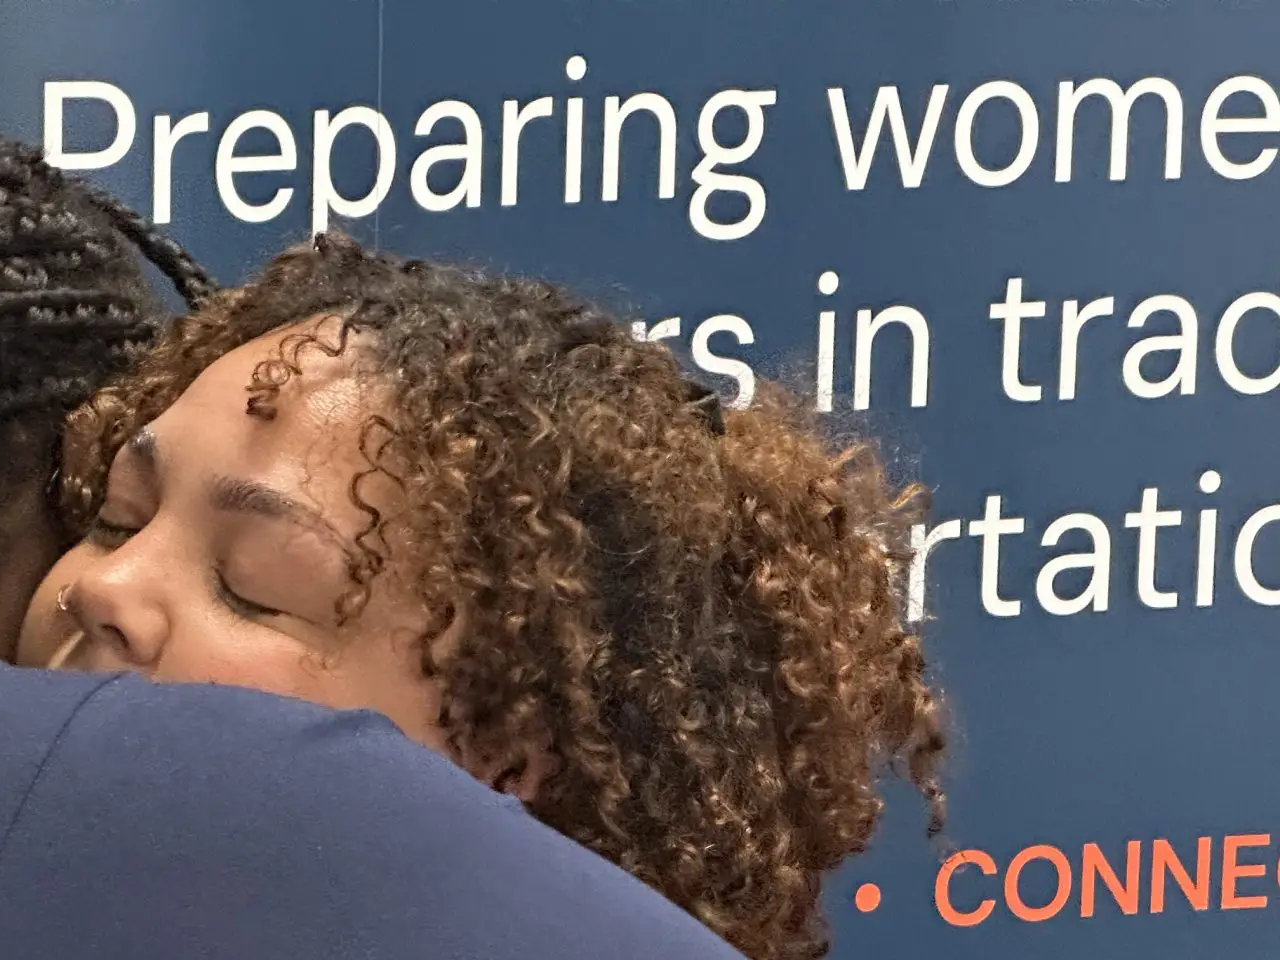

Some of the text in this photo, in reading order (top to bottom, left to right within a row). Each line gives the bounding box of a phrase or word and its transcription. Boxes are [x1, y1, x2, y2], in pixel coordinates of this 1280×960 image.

[44, 56, 1280, 241] Preparing wome
[817, 271, 931, 412] in
[935, 833, 1280, 926] CONNE
